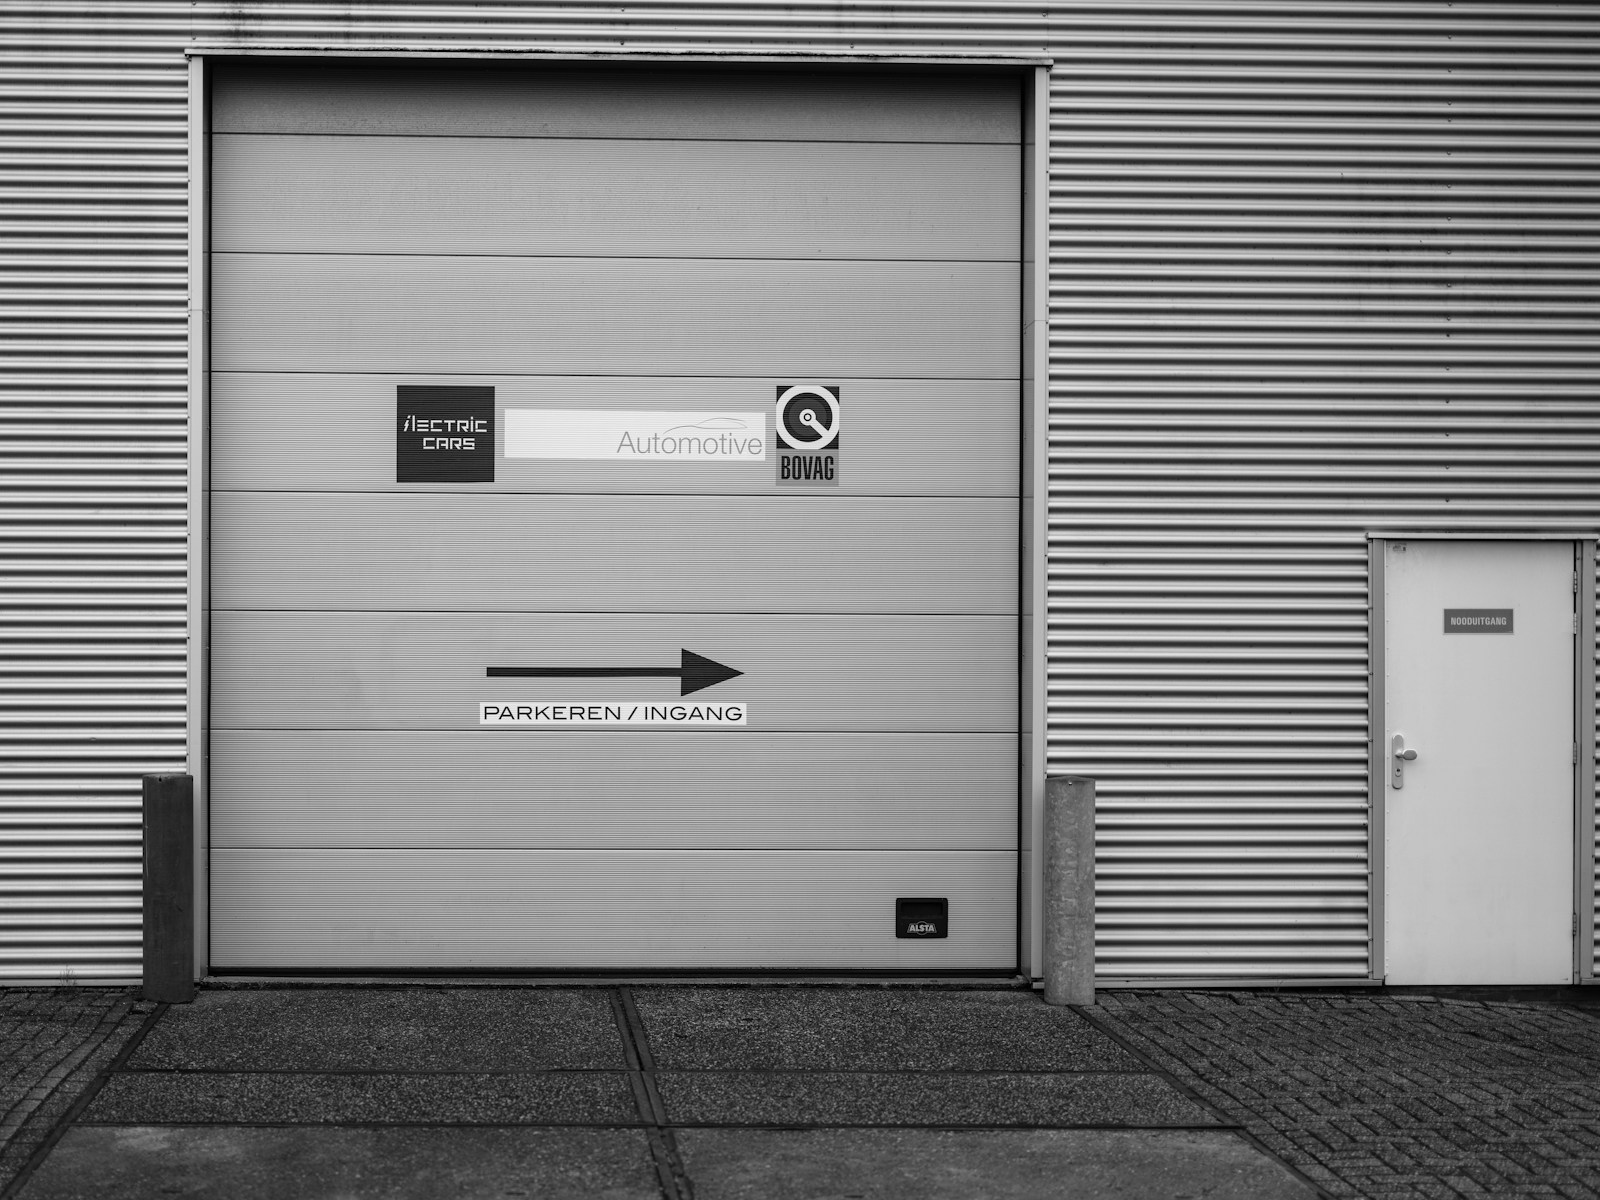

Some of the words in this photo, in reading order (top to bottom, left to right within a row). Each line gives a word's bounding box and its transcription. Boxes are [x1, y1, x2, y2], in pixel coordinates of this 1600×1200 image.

[423, 438, 475, 449] CARS
[616, 431, 763, 455] Automotive
[781, 456, 834, 480] BOVAG
[1450, 617, 1507, 625] NOODUITGANG
[484, 706, 621, 720] PARKEREN
[645, 706, 743, 721] INGANG
[909, 924, 935, 932] ALSTA
